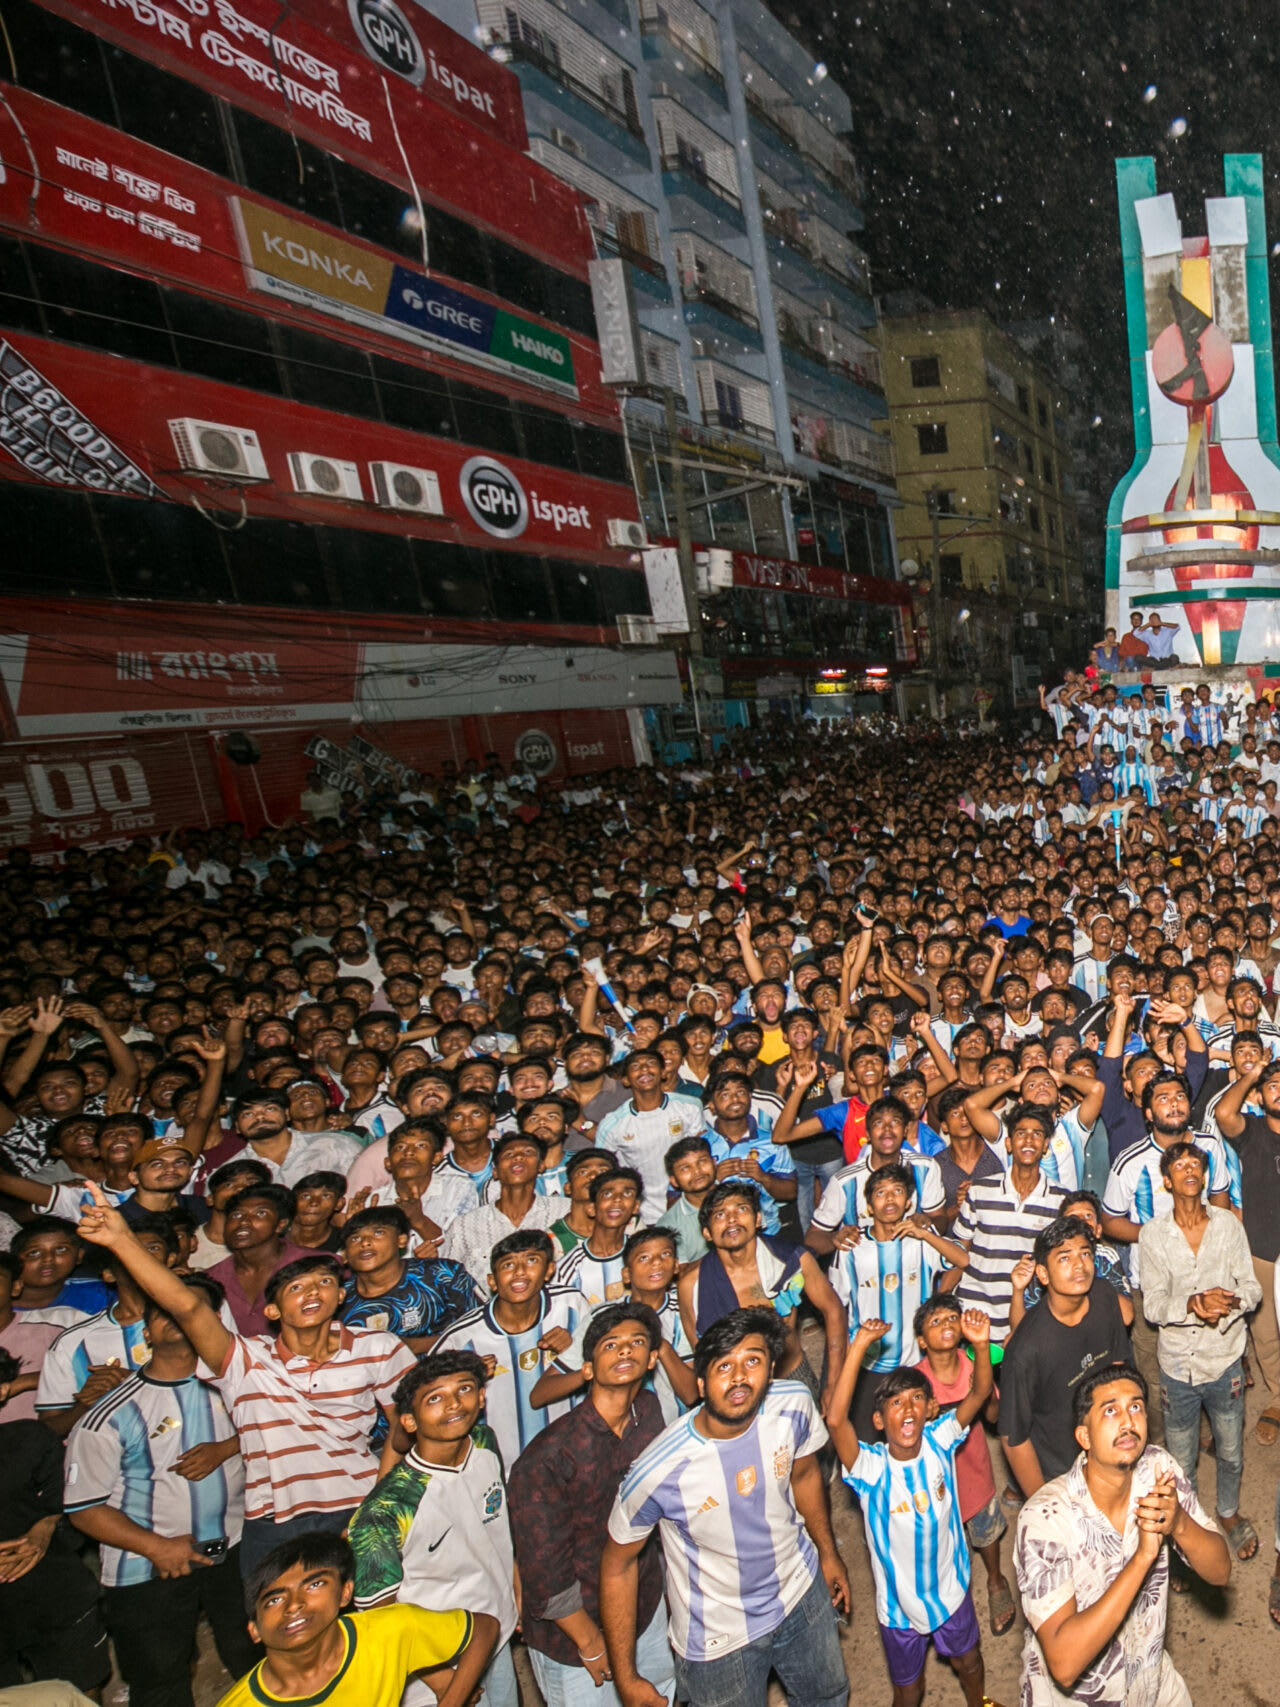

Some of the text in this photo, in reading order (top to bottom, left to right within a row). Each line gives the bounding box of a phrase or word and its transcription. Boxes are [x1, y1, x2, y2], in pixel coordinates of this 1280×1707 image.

[362, 13, 496, 119] GPH ispat
[262, 231, 373, 291] KONKA
[426, 300, 482, 334] GREE
[511, 330, 565, 366] HAIKO
[473, 483, 591, 531] GPH ispat
[500, 674, 537, 685] SONY
[523, 742, 606, 763] GPH ispat
